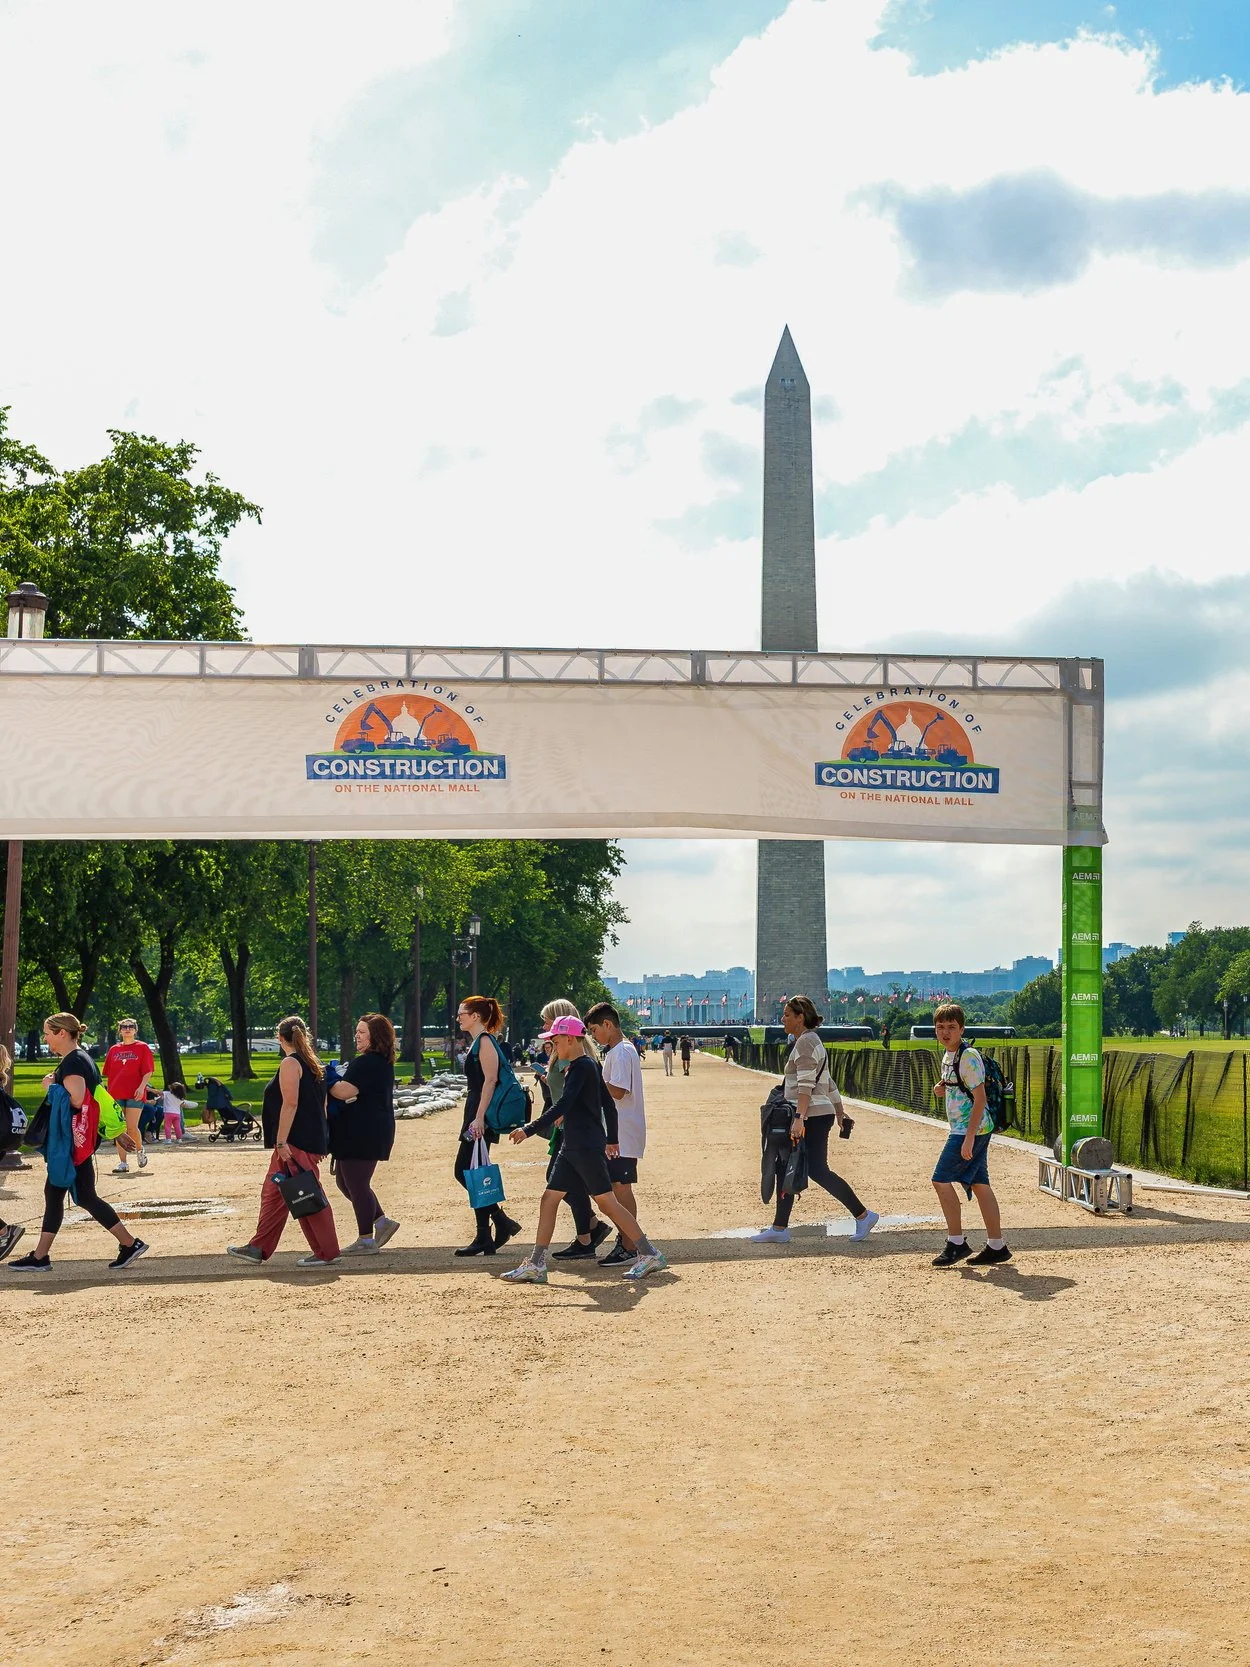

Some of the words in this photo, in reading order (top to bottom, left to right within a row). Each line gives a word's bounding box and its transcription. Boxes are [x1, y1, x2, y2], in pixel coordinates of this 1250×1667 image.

[325, 679, 457, 723] CELEBRATION
[465, 705, 484, 724] OF
[835, 687, 960, 731] CELEBRATION
[965, 714, 982, 734] OF
[313, 758, 499, 776] CONSTRUCTION
[821, 767, 993, 789] CONSTRUCTION
[335, 784, 352, 793] ON
[356, 784, 380, 793] THE
[384, 784, 444, 793] NATIONAL
[449, 784, 481, 793] MALL
[840, 791, 856, 800] ON
[860, 792, 882, 801] THE
[885, 794, 941, 805] NATIONAL
[944, 797, 974, 806] MALL
[1072, 872, 1092, 880] AEM
[1072, 932, 1092, 940] AEM
[1071, 993, 1091, 1001] AEM
[1070, 1053, 1091, 1061] AEM
[1069, 1114, 1090, 1122] AEM
